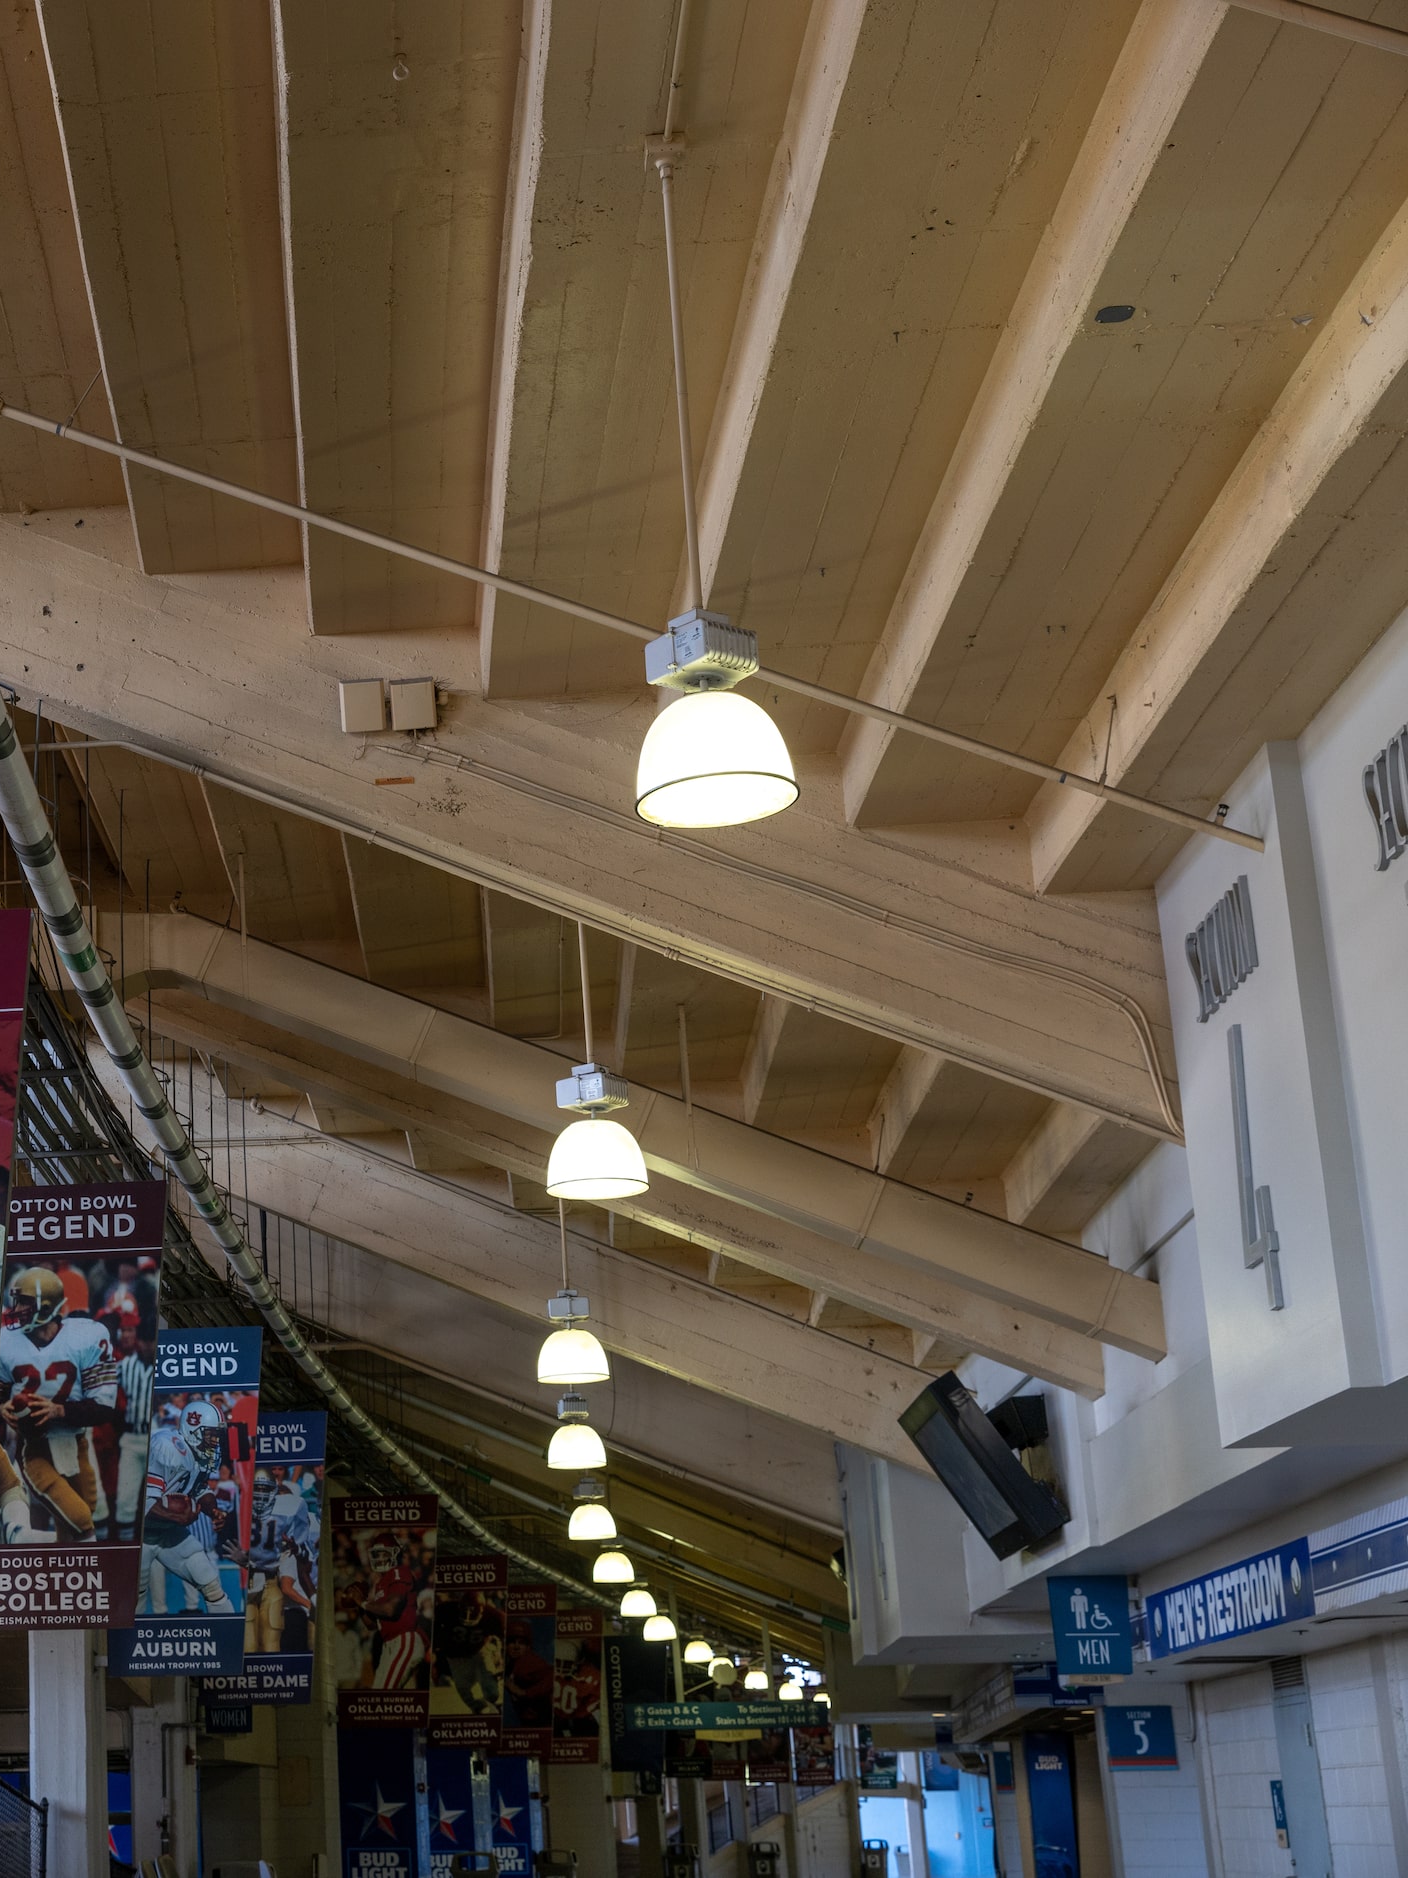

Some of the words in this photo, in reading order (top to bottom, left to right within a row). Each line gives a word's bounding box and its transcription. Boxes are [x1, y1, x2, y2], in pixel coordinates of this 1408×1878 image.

[1227, 1023, 1284, 1312] 4
[80, 1194, 137, 1211] BOWL
[194, 1342, 240, 1354] BOWL
[269, 1423, 307, 1435] BOWL
[255, 1435, 307, 1454] END
[344, 1500, 387, 1509] COTTON
[390, 1499, 421, 1508] BOWL
[344, 1508, 421, 1522] LEGEND
[1, 1556, 44, 1569] DOUG
[48, 1555, 99, 1568] FLUTIE
[435, 1564, 468, 1572] COTTON
[470, 1562, 497, 1571] BOWL
[394, 1569, 401, 1581] 1
[435, 1571, 497, 1584] LEGEND
[1164, 1582, 1207, 1649] MEN'S
[1204, 1554, 1287, 1638] RESTROOM
[41, 1615, 83, 1625] TROPHY
[85, 1614, 110, 1624] 1984
[137, 1629, 154, 1639] BO
[157, 1628, 211, 1638] JACKSON
[131, 1641, 217, 1657] AUBURN
[1078, 1639, 1111, 1665] MEN
[129, 1662, 166, 1670] HEISMAN
[168, 1662, 201, 1670] TROPHY
[202, 1661, 221, 1669] 1985
[246, 1664, 284, 1673] BROWN
[610, 1645, 623, 1700] COTTON
[203, 1675, 258, 1690] NOTRE
[263, 1674, 310, 1688] DAME
[347, 1704, 425, 1715] OKLAHOMA
[647, 1707, 672, 1715] Gates
[674, 1706, 681, 1715] B
[682, 1706, 690, 1715] &
[692, 1706, 699, 1715] C
[737, 1705, 747, 1714] To
[749, 1705, 782, 1714] Sections
[1126, 1711, 1152, 1719] SECTION
[210, 1708, 248, 1728] WOMEN
[648, 1718, 664, 1727] Exit
[673, 1717, 693, 1726] Gate
[694, 1717, 703, 1726] A
[715, 1716, 737, 1726] Stairs
[746, 1716, 776, 1725] Sections
[432, 1728, 498, 1739] OKLAHOMA
[1133, 1719, 1150, 1756] 5
[508, 1740, 530, 1749] SMU
[1037, 1754, 1059, 1763] BUD
[1034, 1762, 1063, 1771] LIGHT
[358, 1852, 400, 1867] BUD
